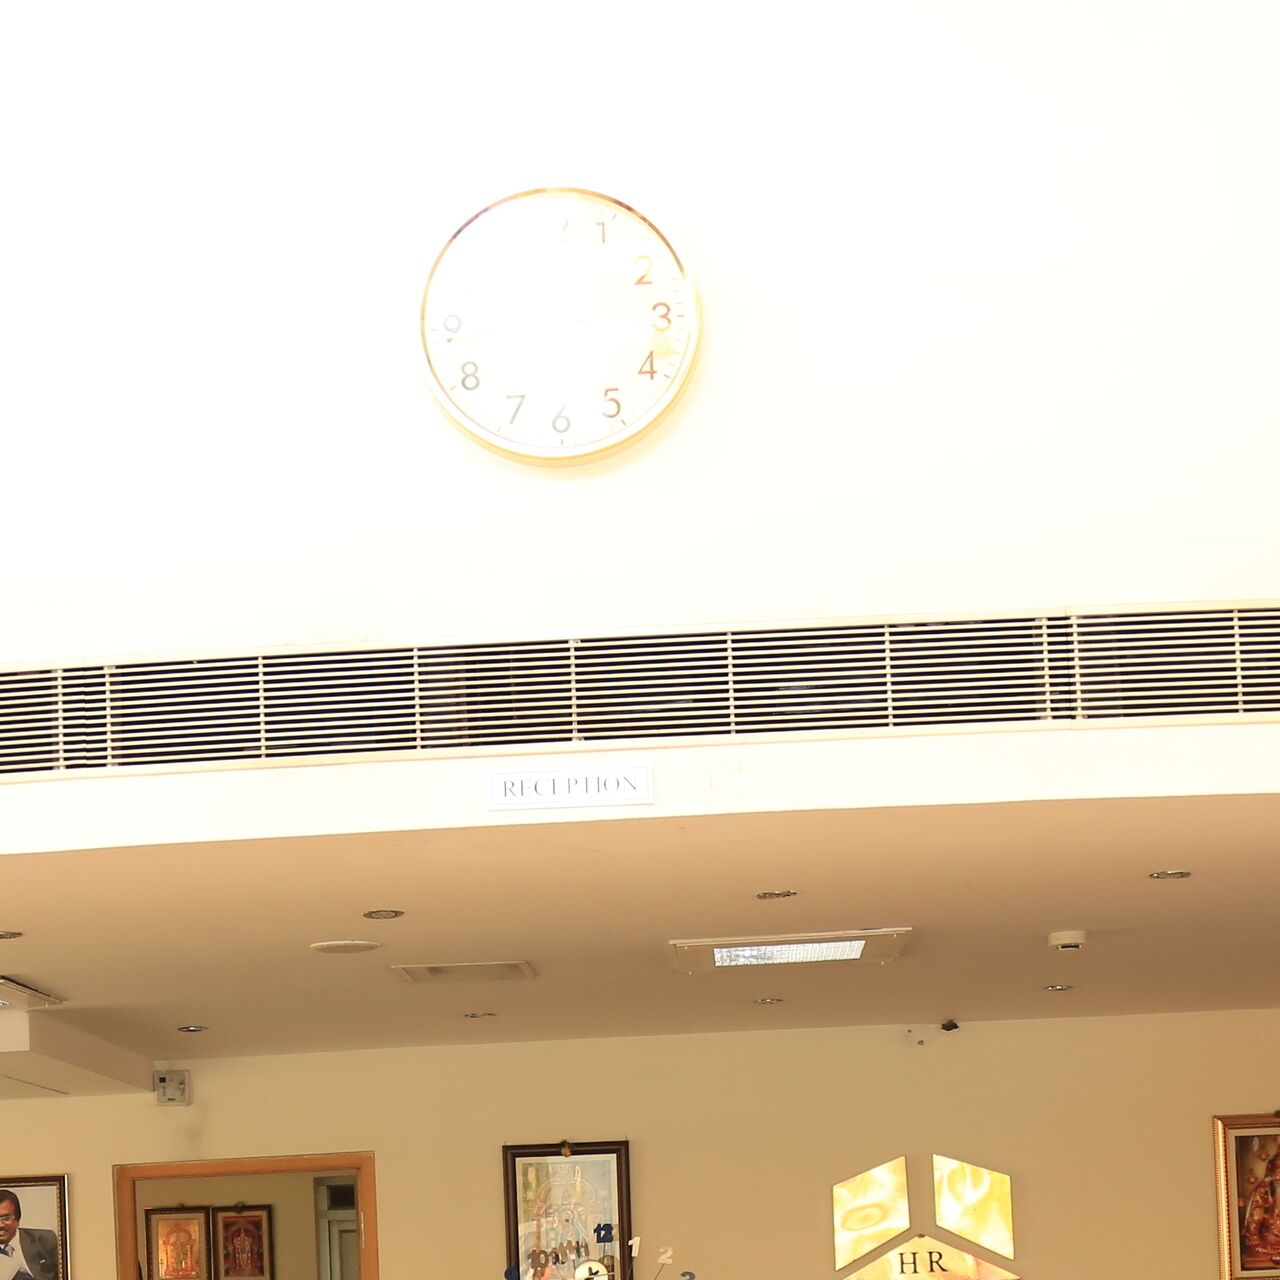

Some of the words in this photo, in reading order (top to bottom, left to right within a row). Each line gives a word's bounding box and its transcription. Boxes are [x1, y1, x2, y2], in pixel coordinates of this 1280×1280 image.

[596, 221, 606, 244] 1
[634, 255, 653, 285] 2
[651, 302, 672, 332] 3
[461, 361, 480, 391] 8
[638, 350, 658, 380] 4
[506, 395, 526, 425] 7
[601, 387, 621, 418] 5
[552, 405, 571, 434] 6
[503, 775, 639, 797] RECEPTION
[628, 1236, 641, 1257] 1
[657, 1246, 674, 1265] 2
[899, 1250, 949, 1274] HR
